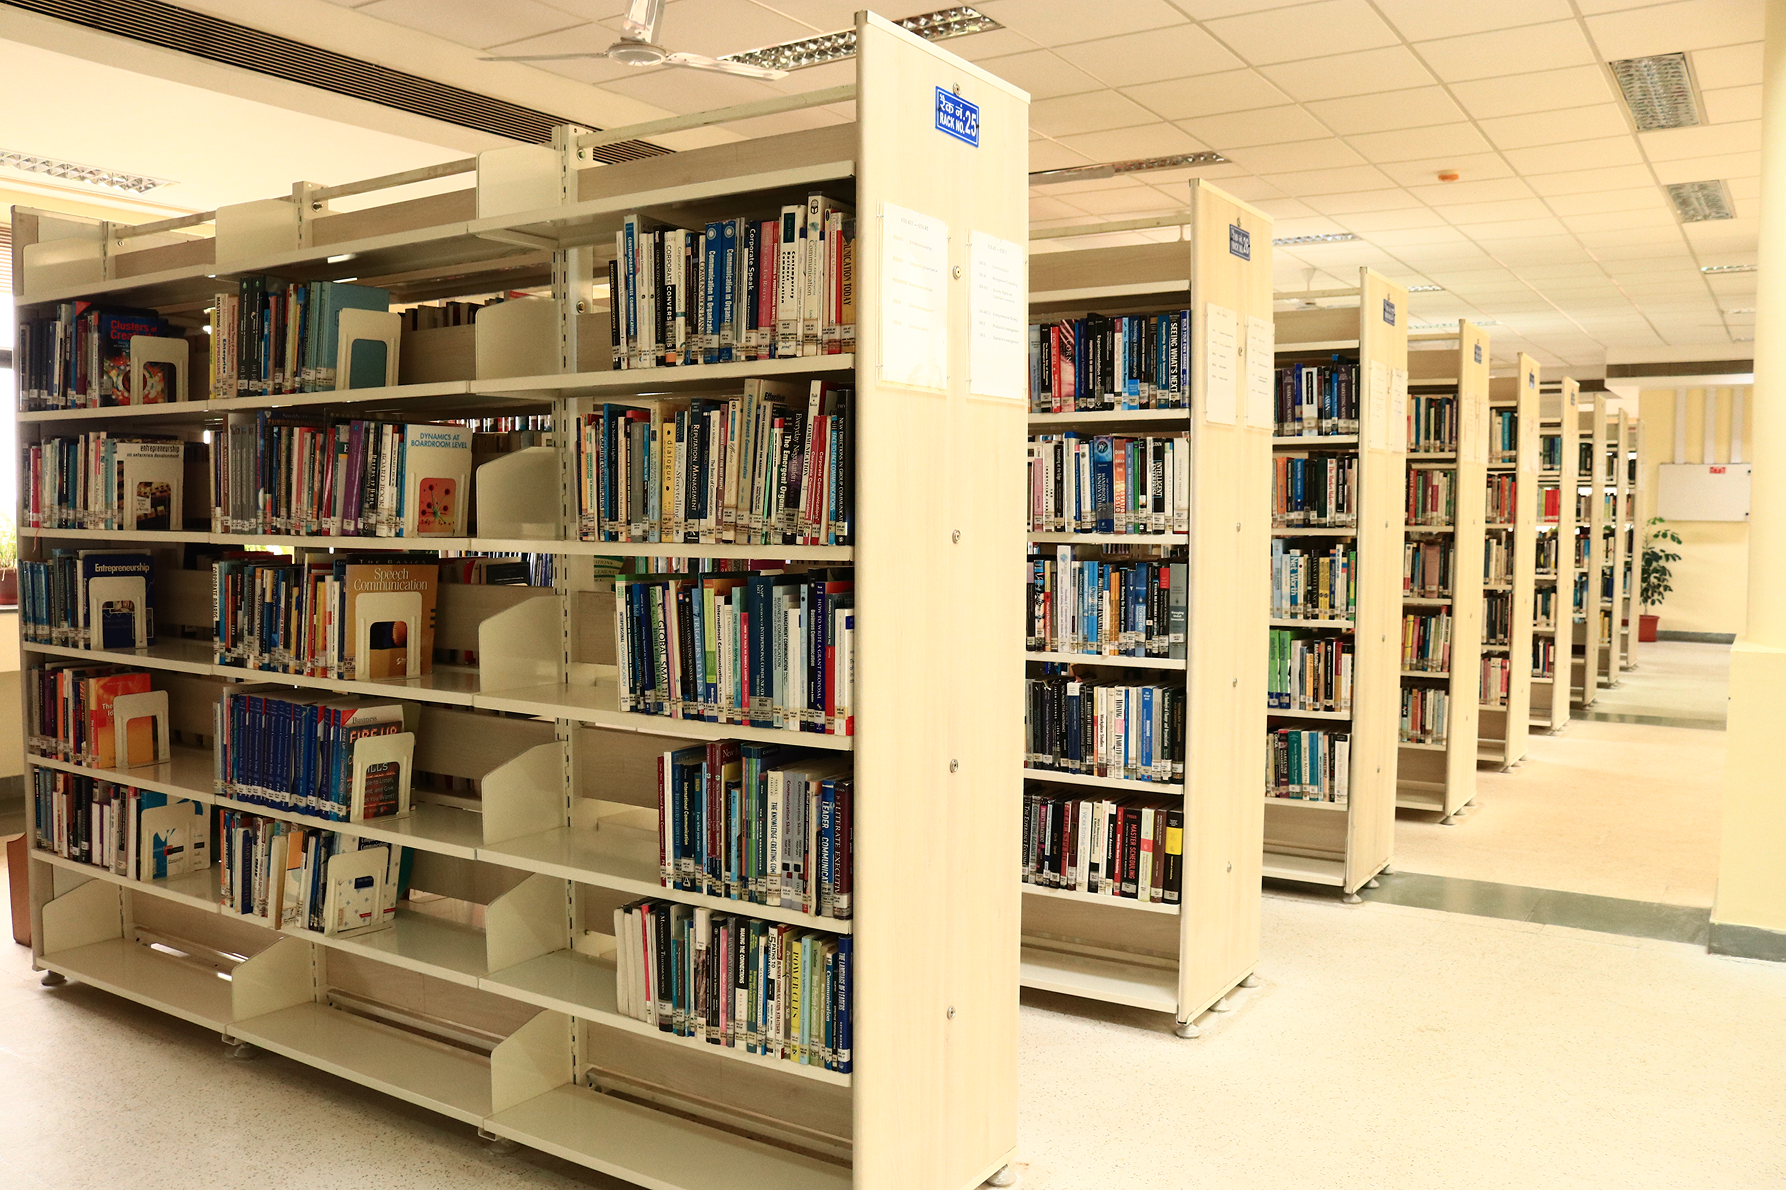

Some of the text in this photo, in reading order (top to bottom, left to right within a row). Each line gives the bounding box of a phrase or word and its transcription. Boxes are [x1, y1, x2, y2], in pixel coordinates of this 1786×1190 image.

[940, 112, 965, 134] RACK NO.
[965, 110, 976, 136] 25
[726, 248, 734, 292] Communication
[842, 284, 852, 306] TODAY
[110, 320, 149, 332] Clusters
[140, 444, 180, 453] entrepreneurship
[790, 413, 802, 482] Everyday Negotiation
[803, 423, 812, 476] COMMUNICATION
[781, 450, 790, 484] Emergent
[805, 478, 814, 519] Communications
[94, 563, 149, 574] Entrepreneurship
[374, 568, 409, 581] Speech
[354, 579, 428, 592] Communication
[817, 613, 822, 624] TO
[658, 620, 666, 656] GLOBAL
[697, 659, 702, 671] TO
